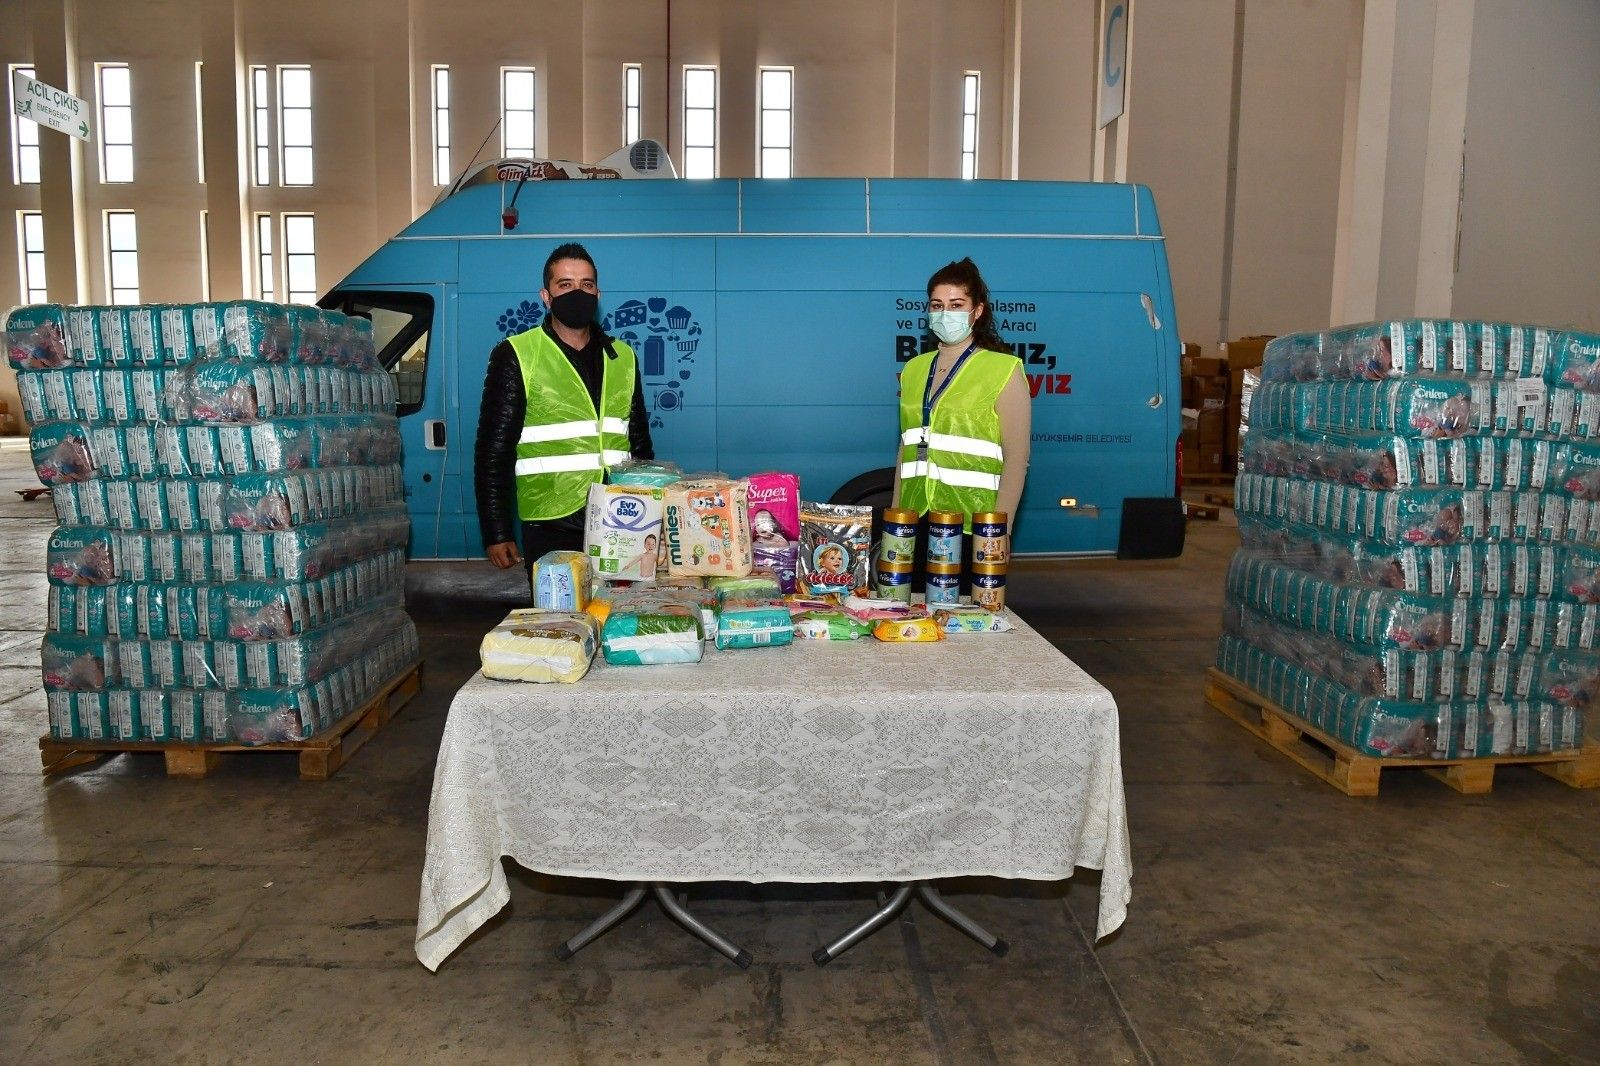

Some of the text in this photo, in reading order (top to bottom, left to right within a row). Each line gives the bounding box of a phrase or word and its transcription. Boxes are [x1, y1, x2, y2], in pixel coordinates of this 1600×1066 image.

[1106, 5, 1123, 87] C
[27, 81, 79, 115] ACİL ÇIKIŞ
[36, 103, 71, 121] EMERGENCY
[48, 118, 61, 128] EXIT
[896, 299, 930, 313] Sosy
[896, 319, 913, 330] ve
[1001, 319, 1036, 331] Aracı
[1031, 433, 1132, 443] ÜYÜKŞEHİR BELEDİYESİ
[748, 484, 787, 503] Super
[620, 500, 637, 510] Evy
[616, 507, 640, 518] Baby
[666, 505, 682, 566] minies
